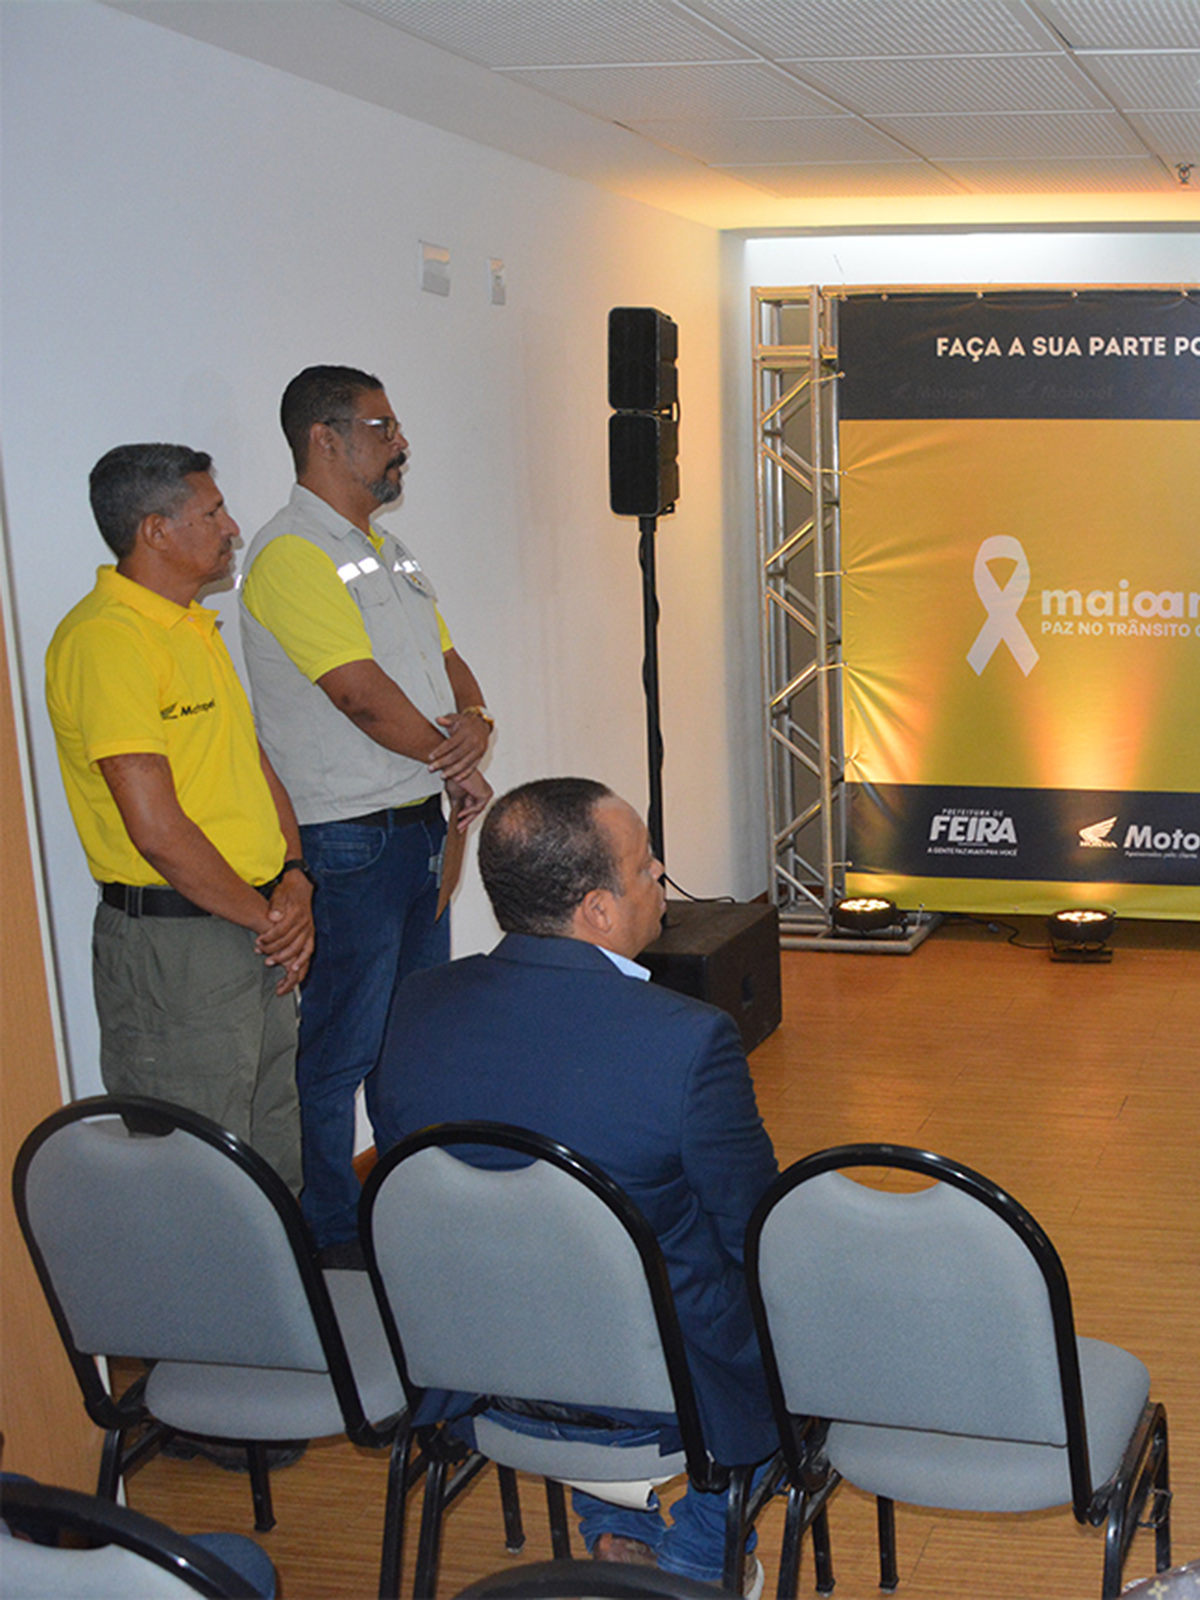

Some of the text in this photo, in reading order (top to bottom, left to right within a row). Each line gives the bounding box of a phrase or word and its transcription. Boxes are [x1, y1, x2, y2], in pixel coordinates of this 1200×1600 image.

[937, 337, 1001, 362] FAÇA
[1008, 337, 1026, 356] A
[1032, 337, 1082, 357] SUA
[1089, 337, 1166, 357] PARTE
[1041, 621, 1074, 635] PAZ
[1078, 621, 1103, 636] NO
[1107, 619, 1191, 637] TRÂNSITO
[929, 815, 1017, 843] FEIRA
